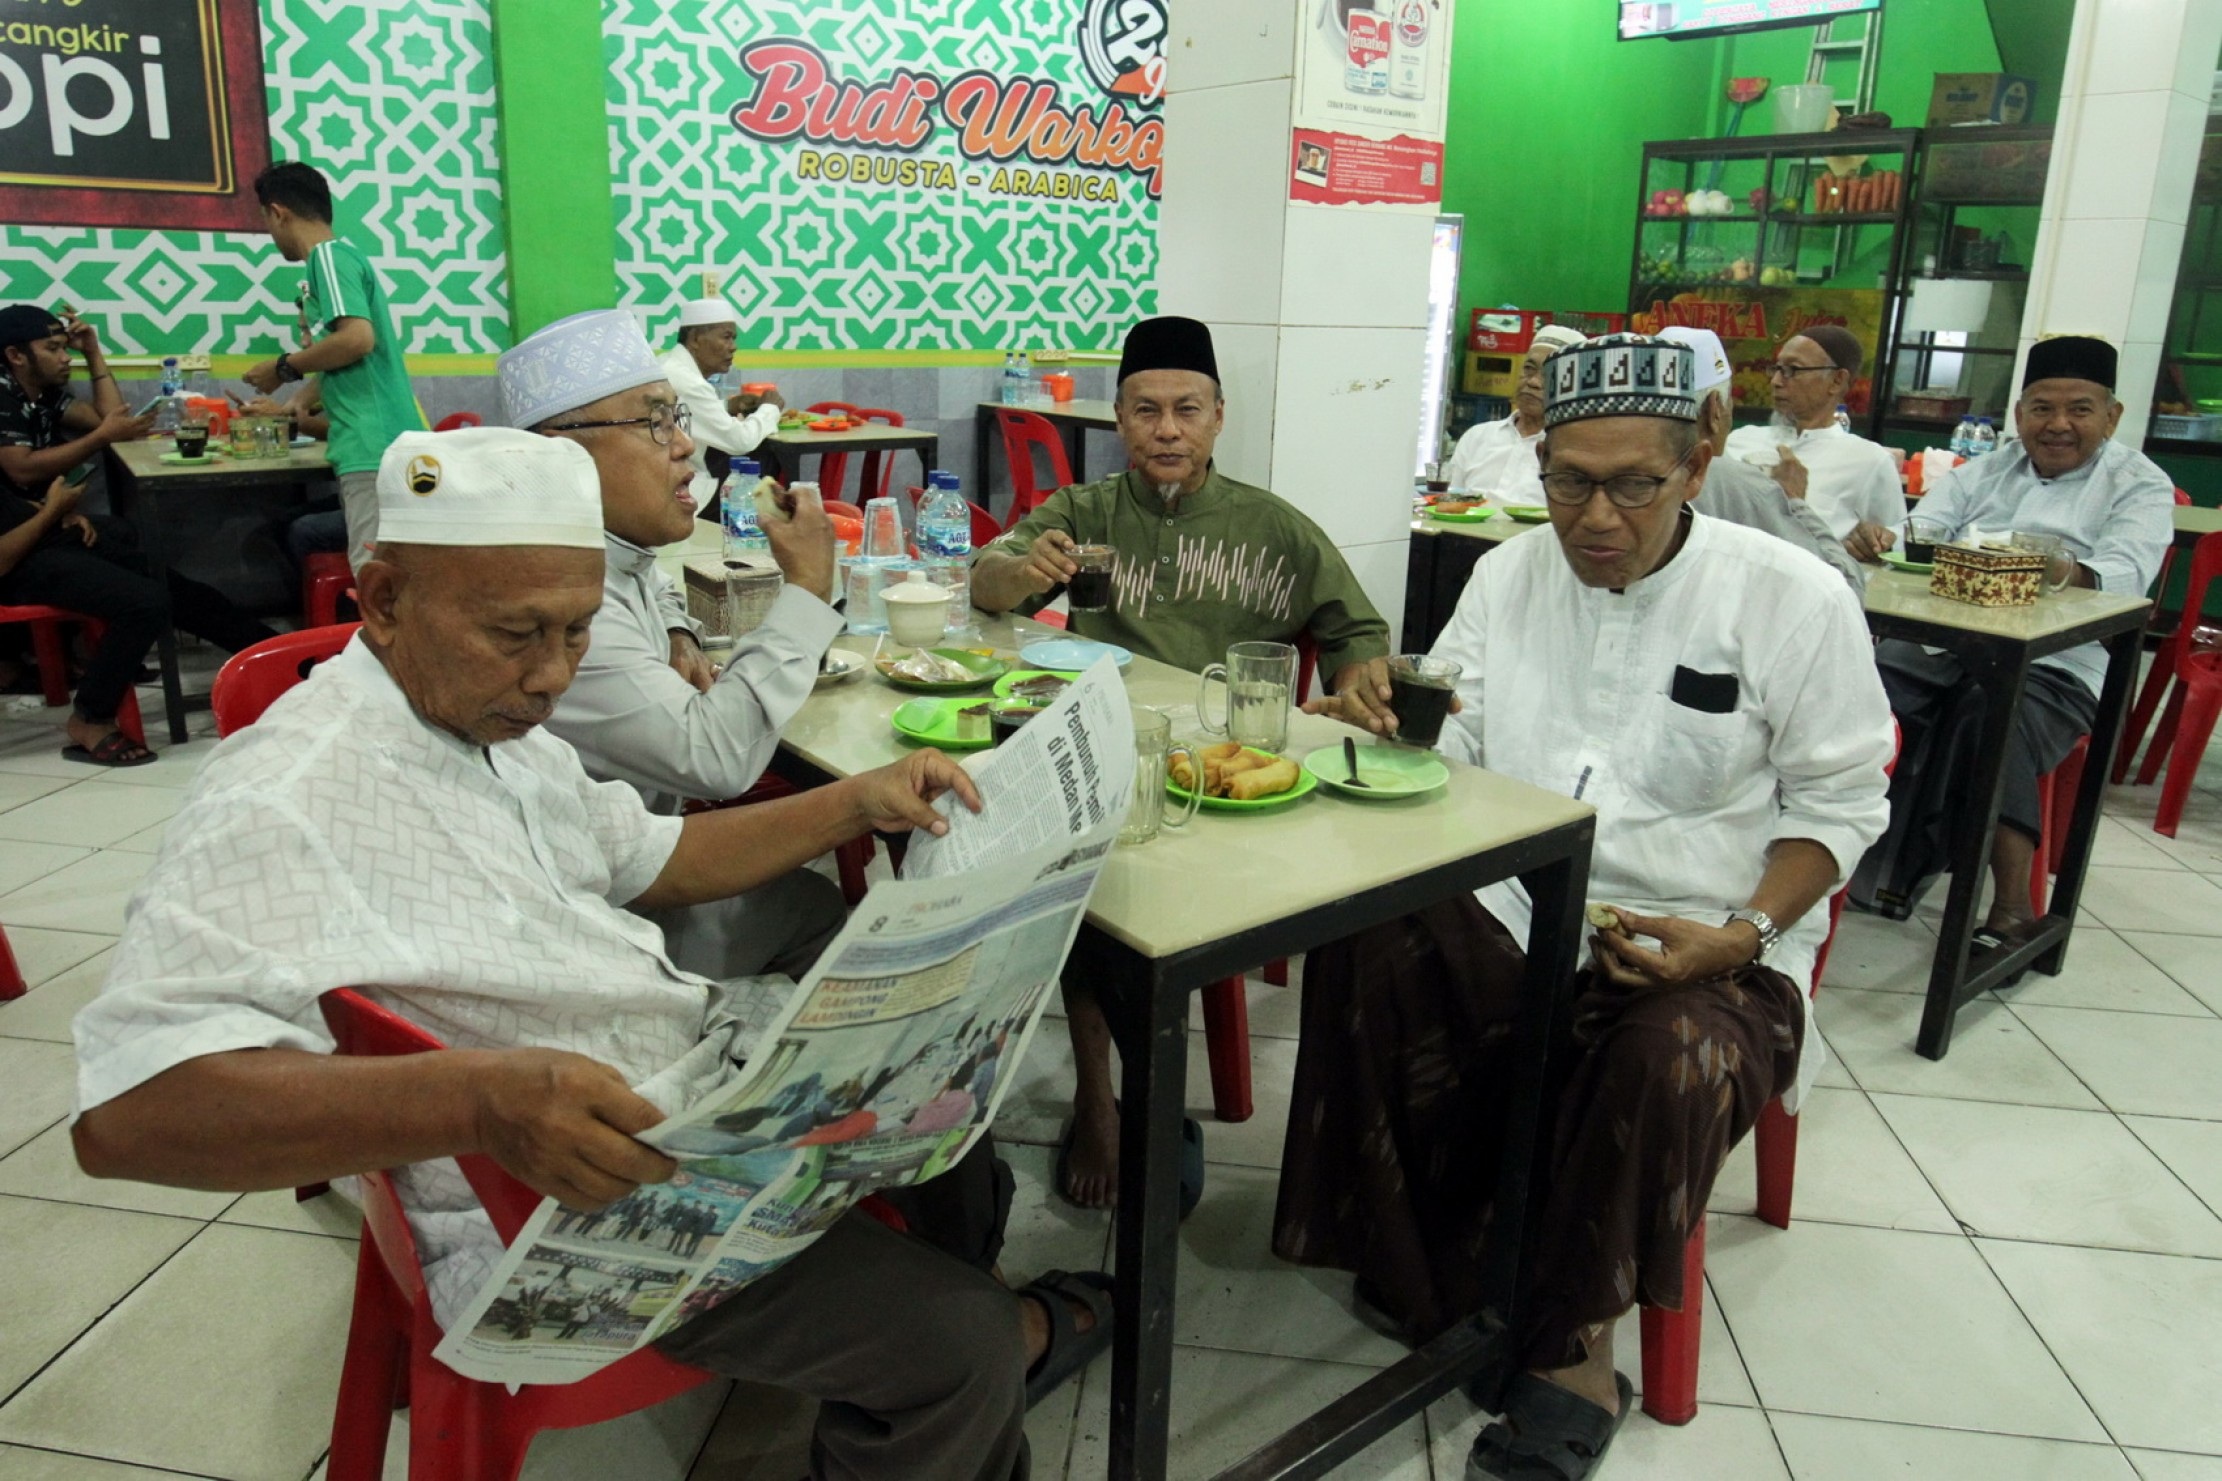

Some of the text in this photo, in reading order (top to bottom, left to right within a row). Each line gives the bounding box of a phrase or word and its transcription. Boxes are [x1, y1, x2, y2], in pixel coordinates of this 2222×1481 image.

[0, 22, 130, 55] angkir
[736, 46, 938, 144] Budi
[799, 151, 957, 190] ROBUSTA
[989, 168, 1119, 202] ARABICA
[1643, 301, 1767, 339] ANEKA
[1047, 736, 1067, 757] di
[1064, 701, 1099, 786] Pembunuh
[1055, 751, 1080, 813] Medan
[868, 915, 889, 933] 8
